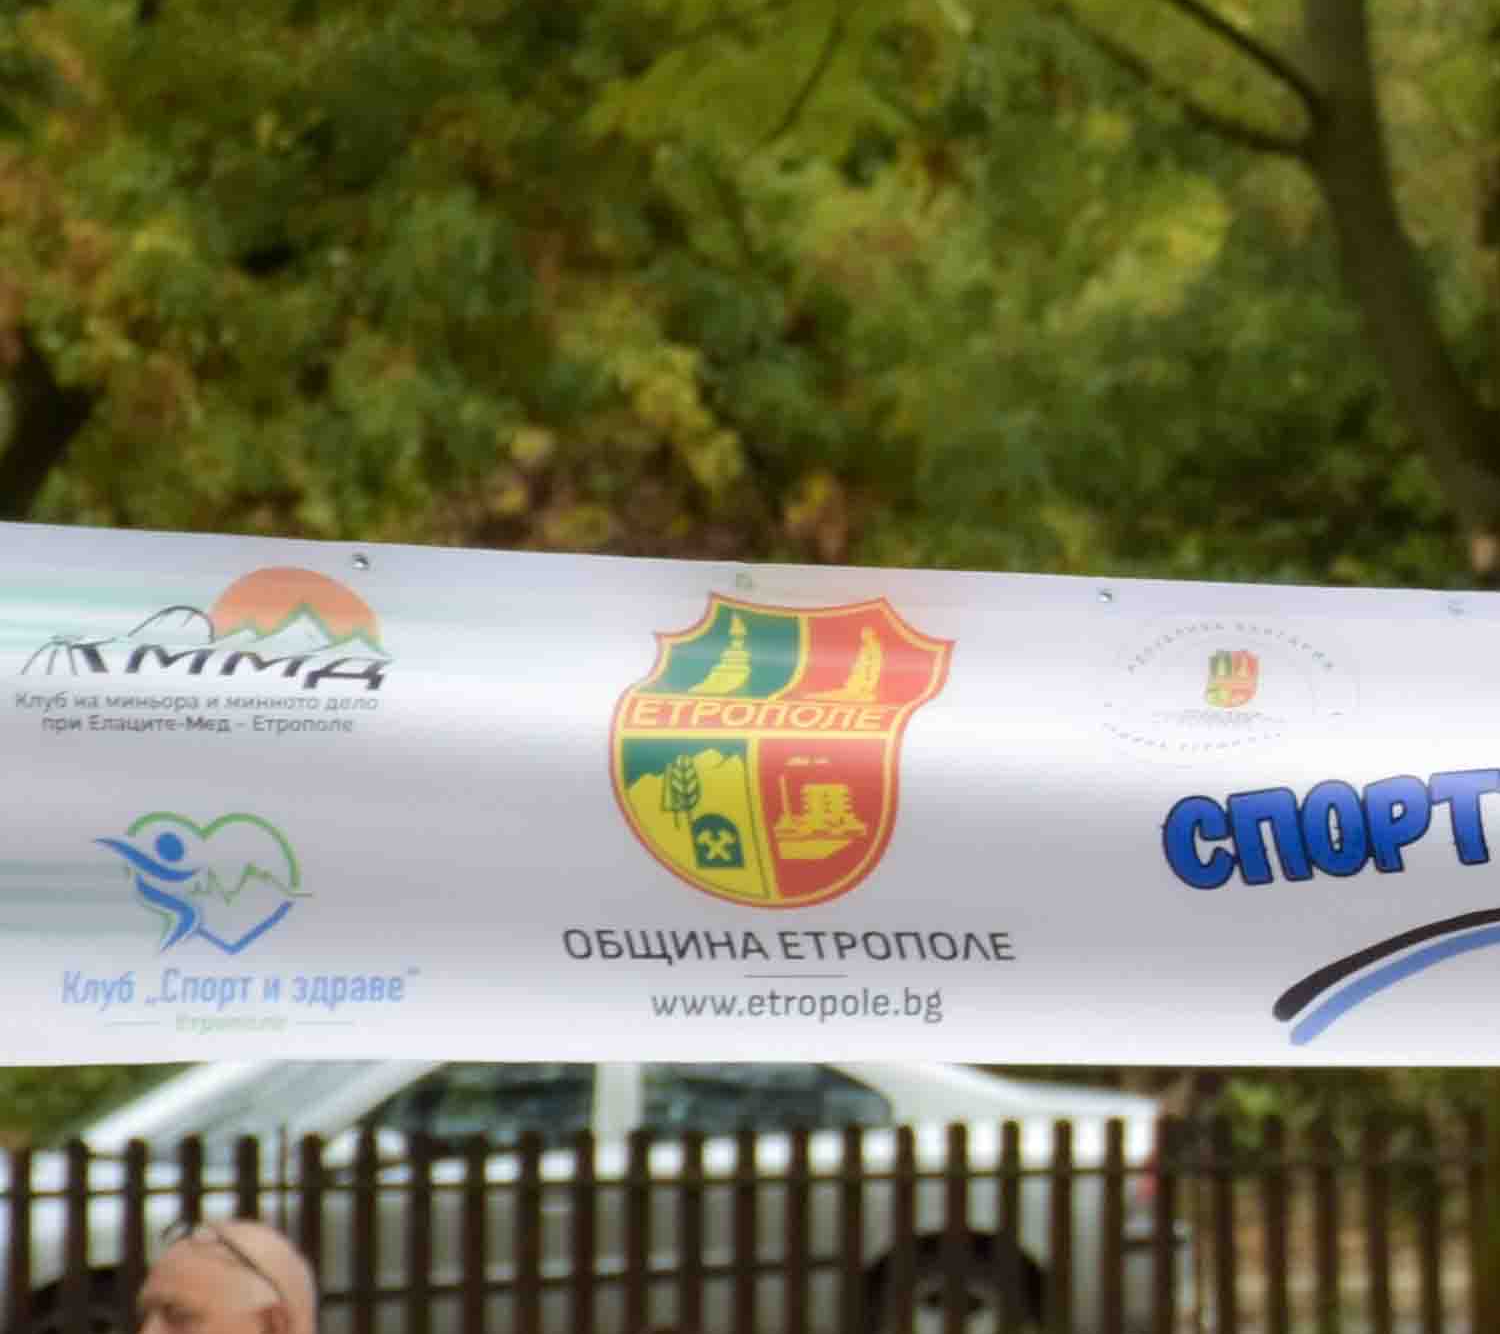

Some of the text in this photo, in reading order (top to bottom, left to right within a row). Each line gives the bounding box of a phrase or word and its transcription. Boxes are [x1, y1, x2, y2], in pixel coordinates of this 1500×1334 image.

[15, 692, 66, 714] Клуб
[74, 695, 99, 711] на
[629, 697, 883, 731] ЕТРОПОЛЕ
[252, 715, 354, 735] Етрополе
[562, 927, 1017, 966] ОБЩИНА ЕТРОПОЛЕ
[61, 969, 137, 1012] Клуб
[262, 975, 281, 1005] и
[651, 986, 944, 1025] www.etropole.bg
